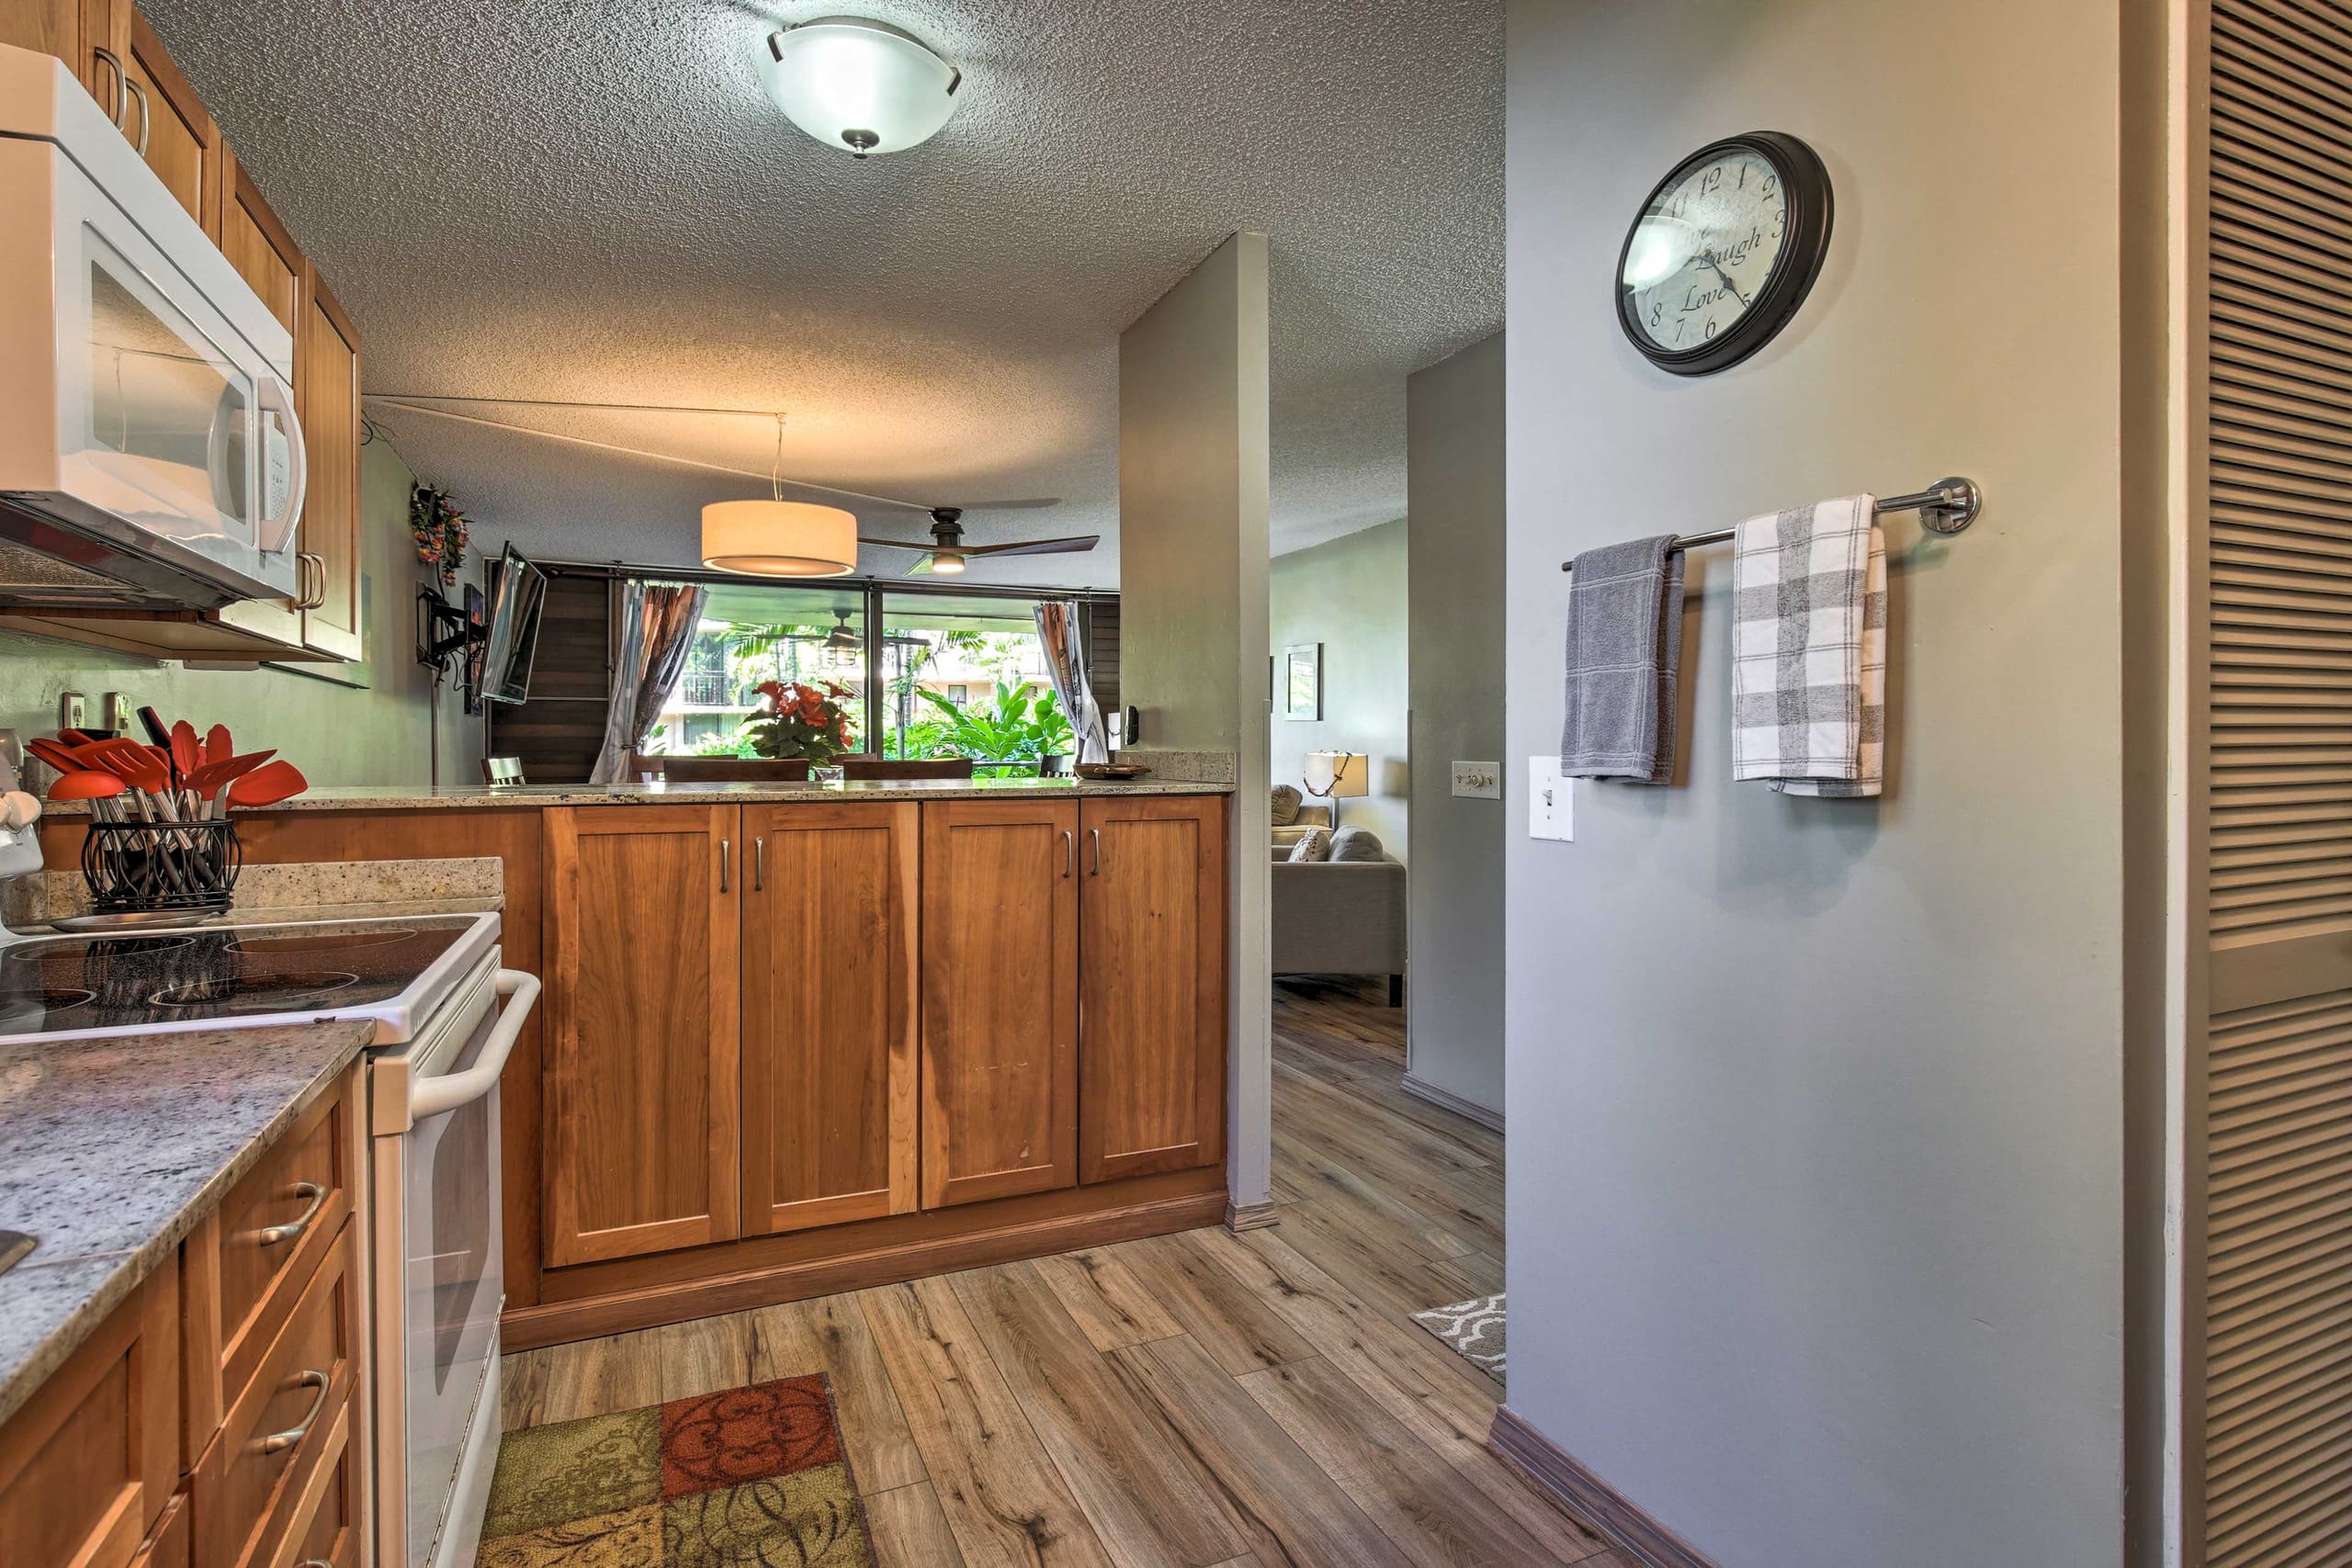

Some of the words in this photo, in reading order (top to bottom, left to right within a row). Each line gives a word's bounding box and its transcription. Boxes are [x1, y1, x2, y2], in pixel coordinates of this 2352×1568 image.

[1700, 166, 1722, 196] 12
[1737, 162, 1748, 190] 1
[1762, 175, 1777, 202] 2
[1680, 285, 1728, 312] Love
[1651, 302, 1663, 327] 8
[1704, 314, 1716, 340] 6
[1676, 317, 1686, 343] 7
